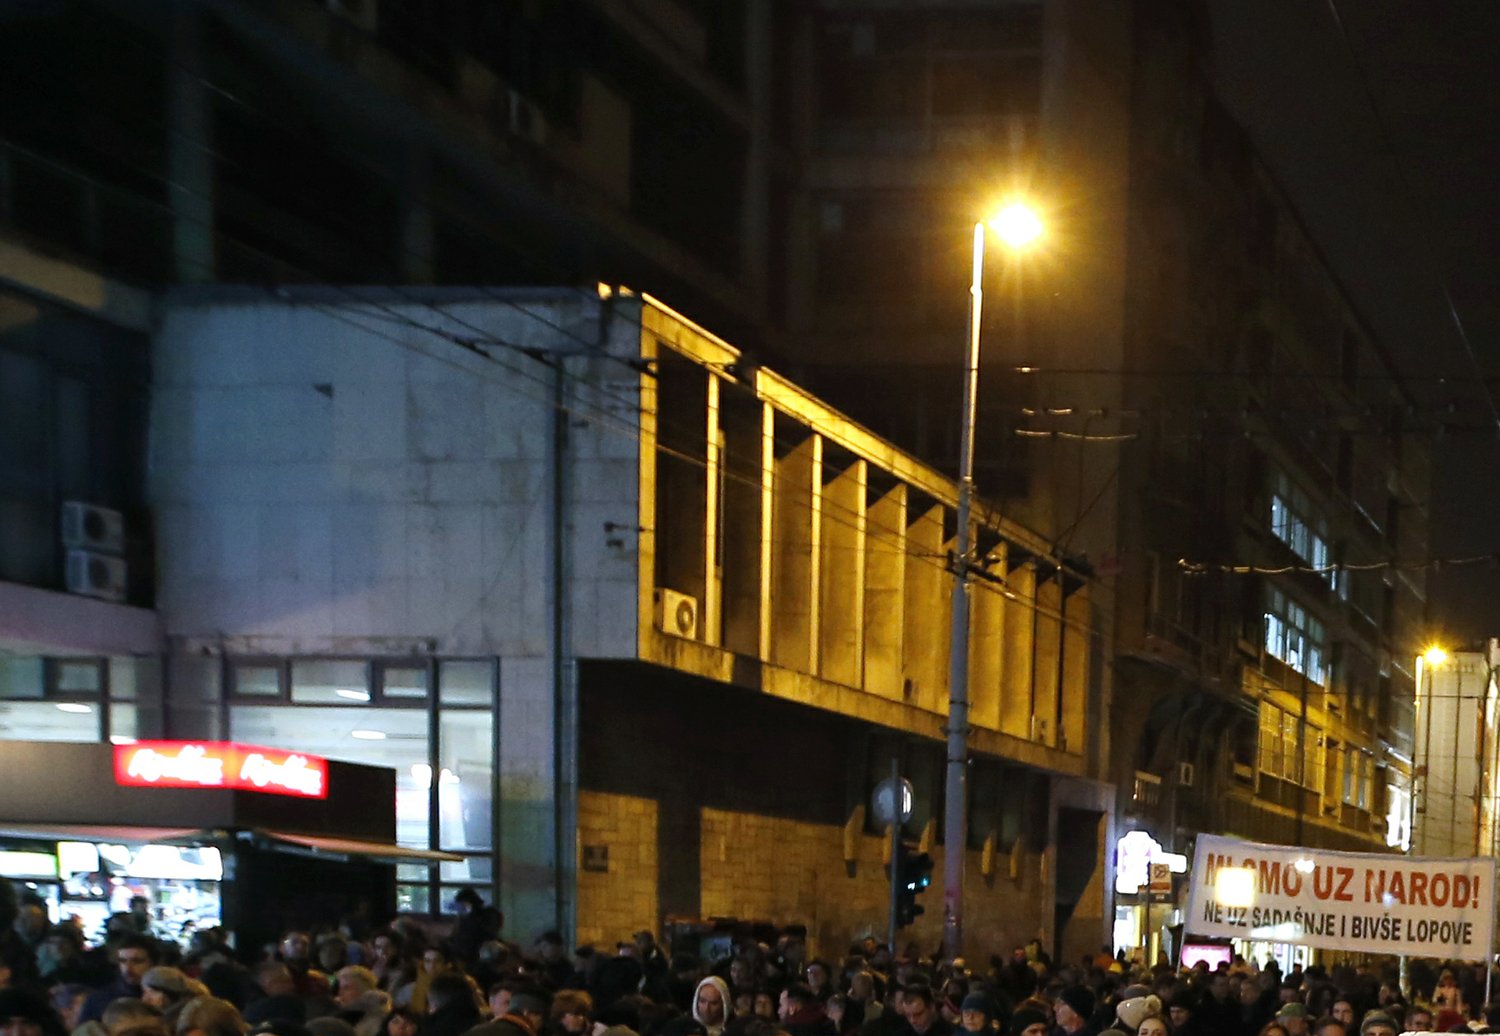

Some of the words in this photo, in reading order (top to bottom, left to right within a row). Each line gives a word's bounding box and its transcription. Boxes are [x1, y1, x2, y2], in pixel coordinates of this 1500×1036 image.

[1242, 858, 1303, 897] MO
[1313, 865, 1354, 902] UZ
[1364, 869, 1480, 909] NAROD!
[1204, 900, 1223, 923] NE
[1341, 915, 1346, 937] I
[1352, 912, 1401, 940] BIVŠE
[1407, 919, 1472, 944] LOPOVE
